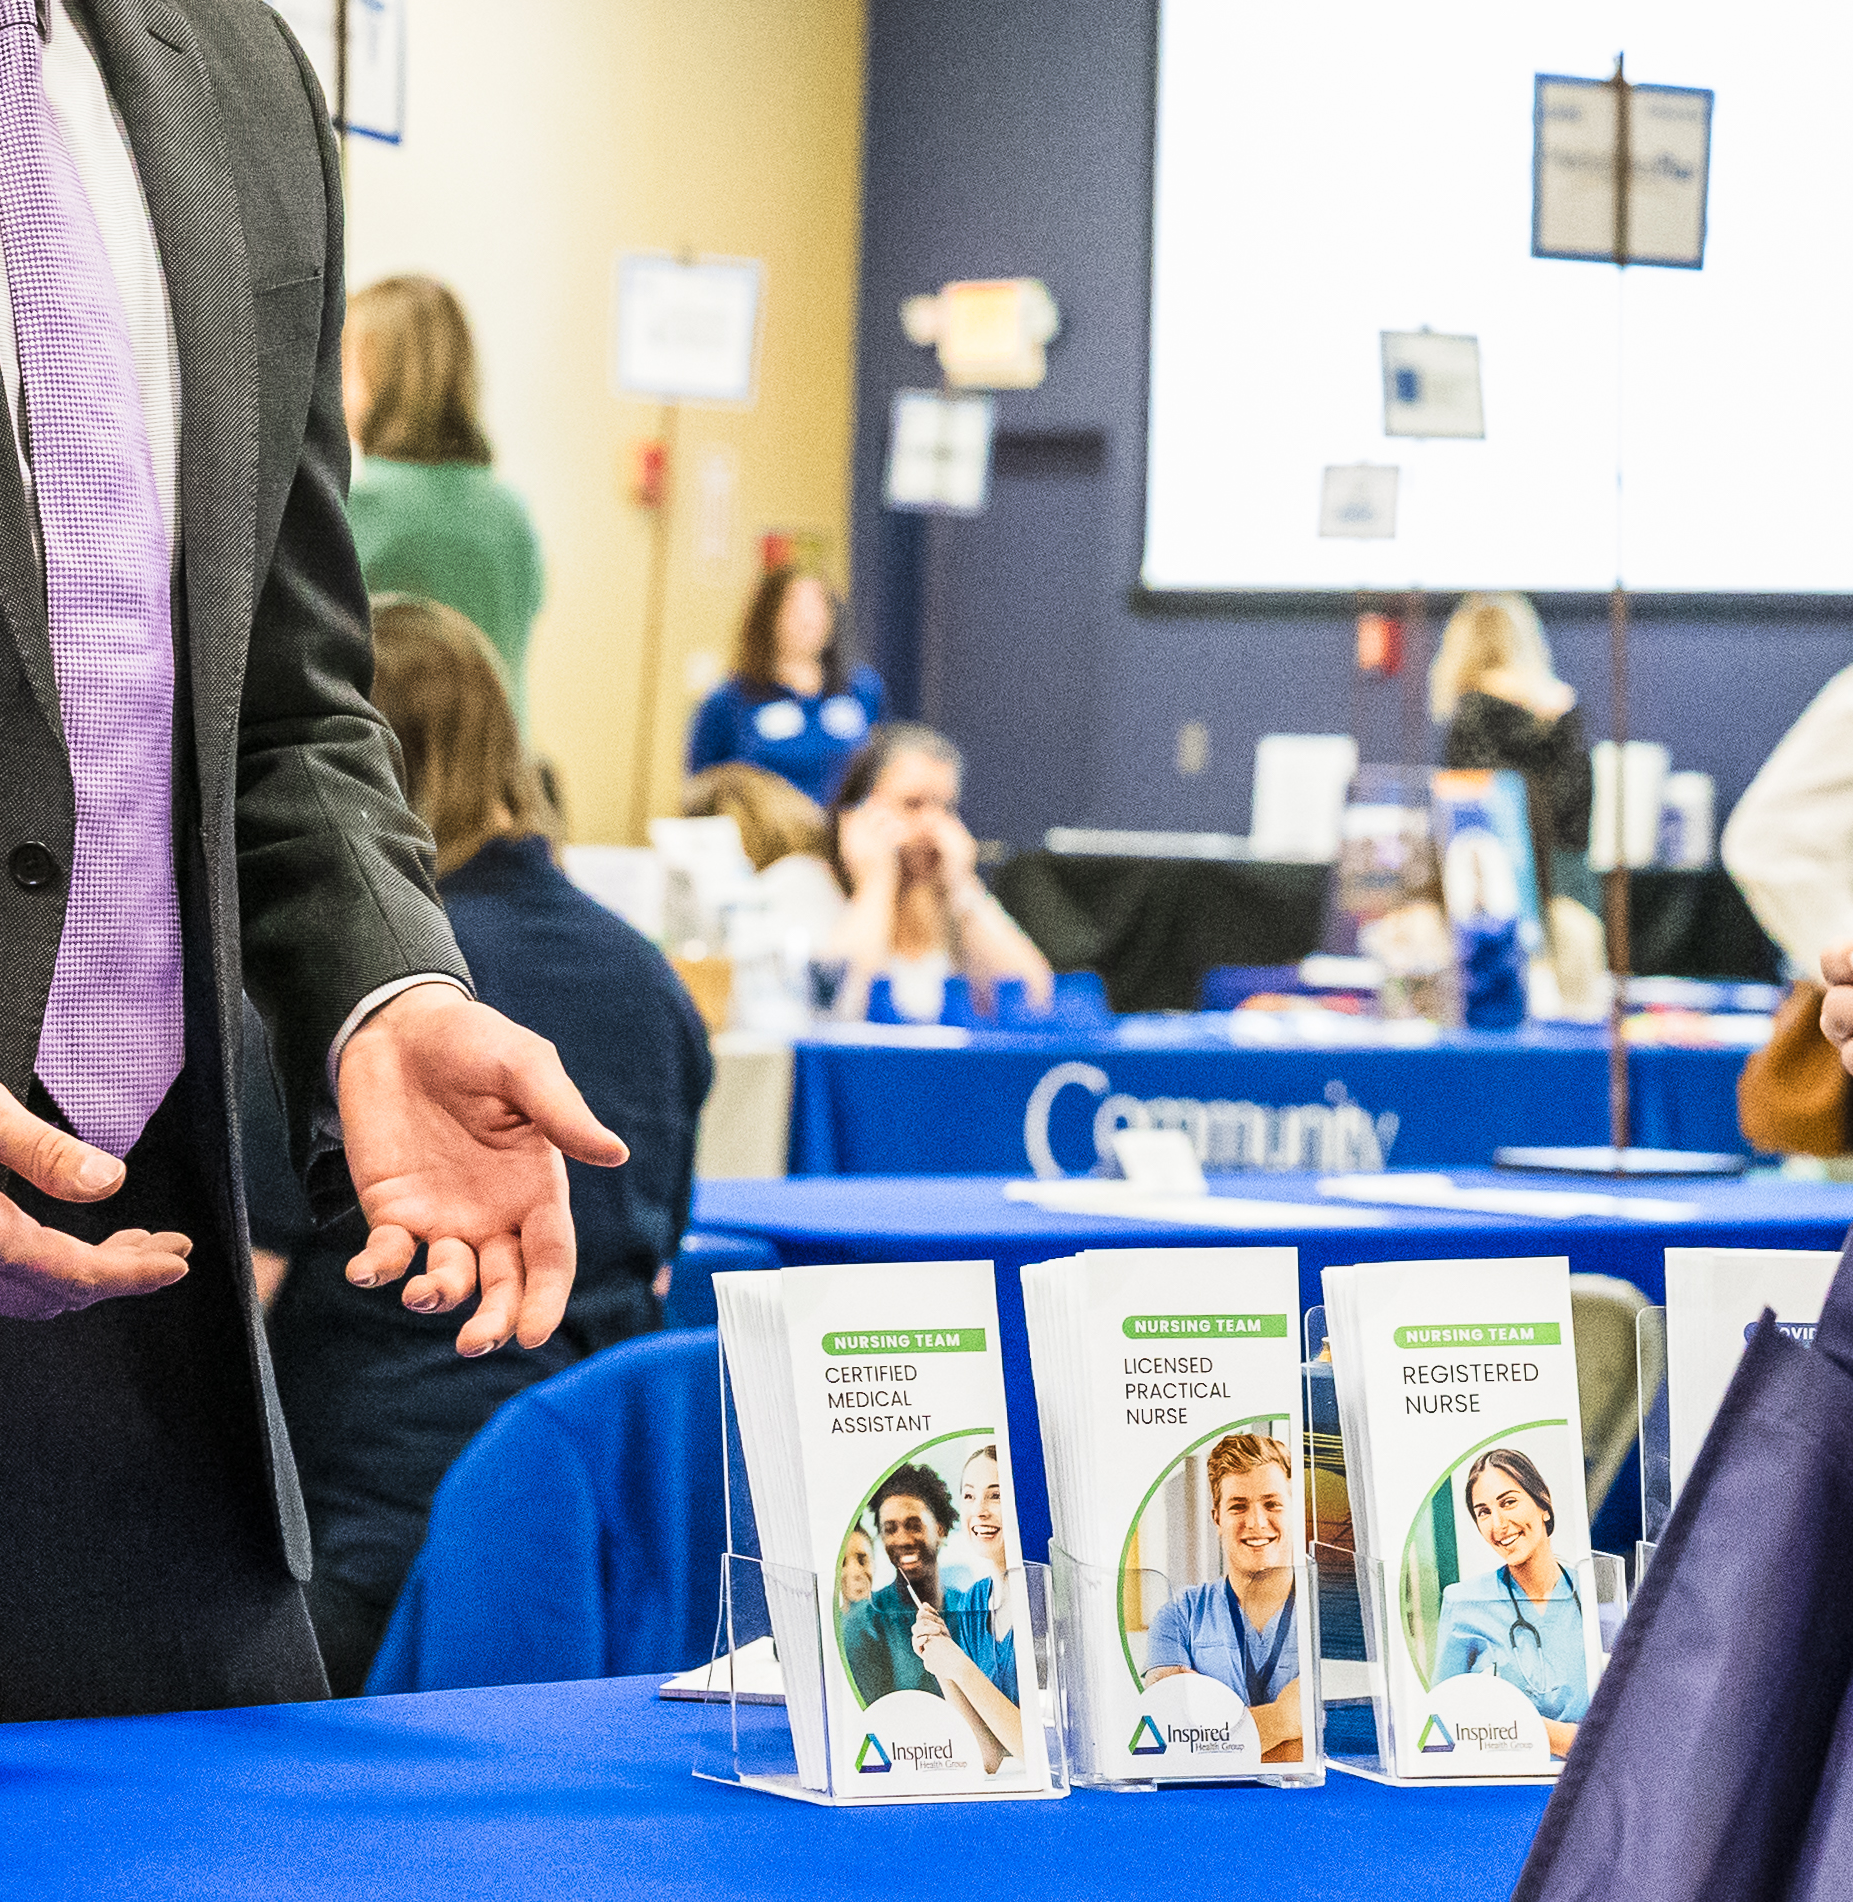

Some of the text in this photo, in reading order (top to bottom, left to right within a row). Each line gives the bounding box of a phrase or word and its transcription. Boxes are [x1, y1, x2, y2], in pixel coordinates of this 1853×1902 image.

[1135, 1319, 1261, 1333] NURSING TEAM
[1406, 1327, 1535, 1343] NURSING TEAM
[834, 1333, 961, 1349] NURSING TEAM
[825, 1365, 917, 1384] CERTIFIED
[1124, 1357, 1213, 1375] LICENSED
[1403, 1363, 1539, 1385] REGISTERED
[827, 1390, 912, 1409] MEDICAL
[1125, 1382, 1231, 1399] PRACTICAL
[1405, 1393, 1481, 1415] NURSE
[831, 1415, 932, 1434] ASSISTANT
[1126, 1407, 1188, 1425] NURSE
[1167, 1721, 1230, 1753] Inspired
[1456, 1720, 1518, 1751] Inspired
[892, 1739, 953, 1770] Inspired
